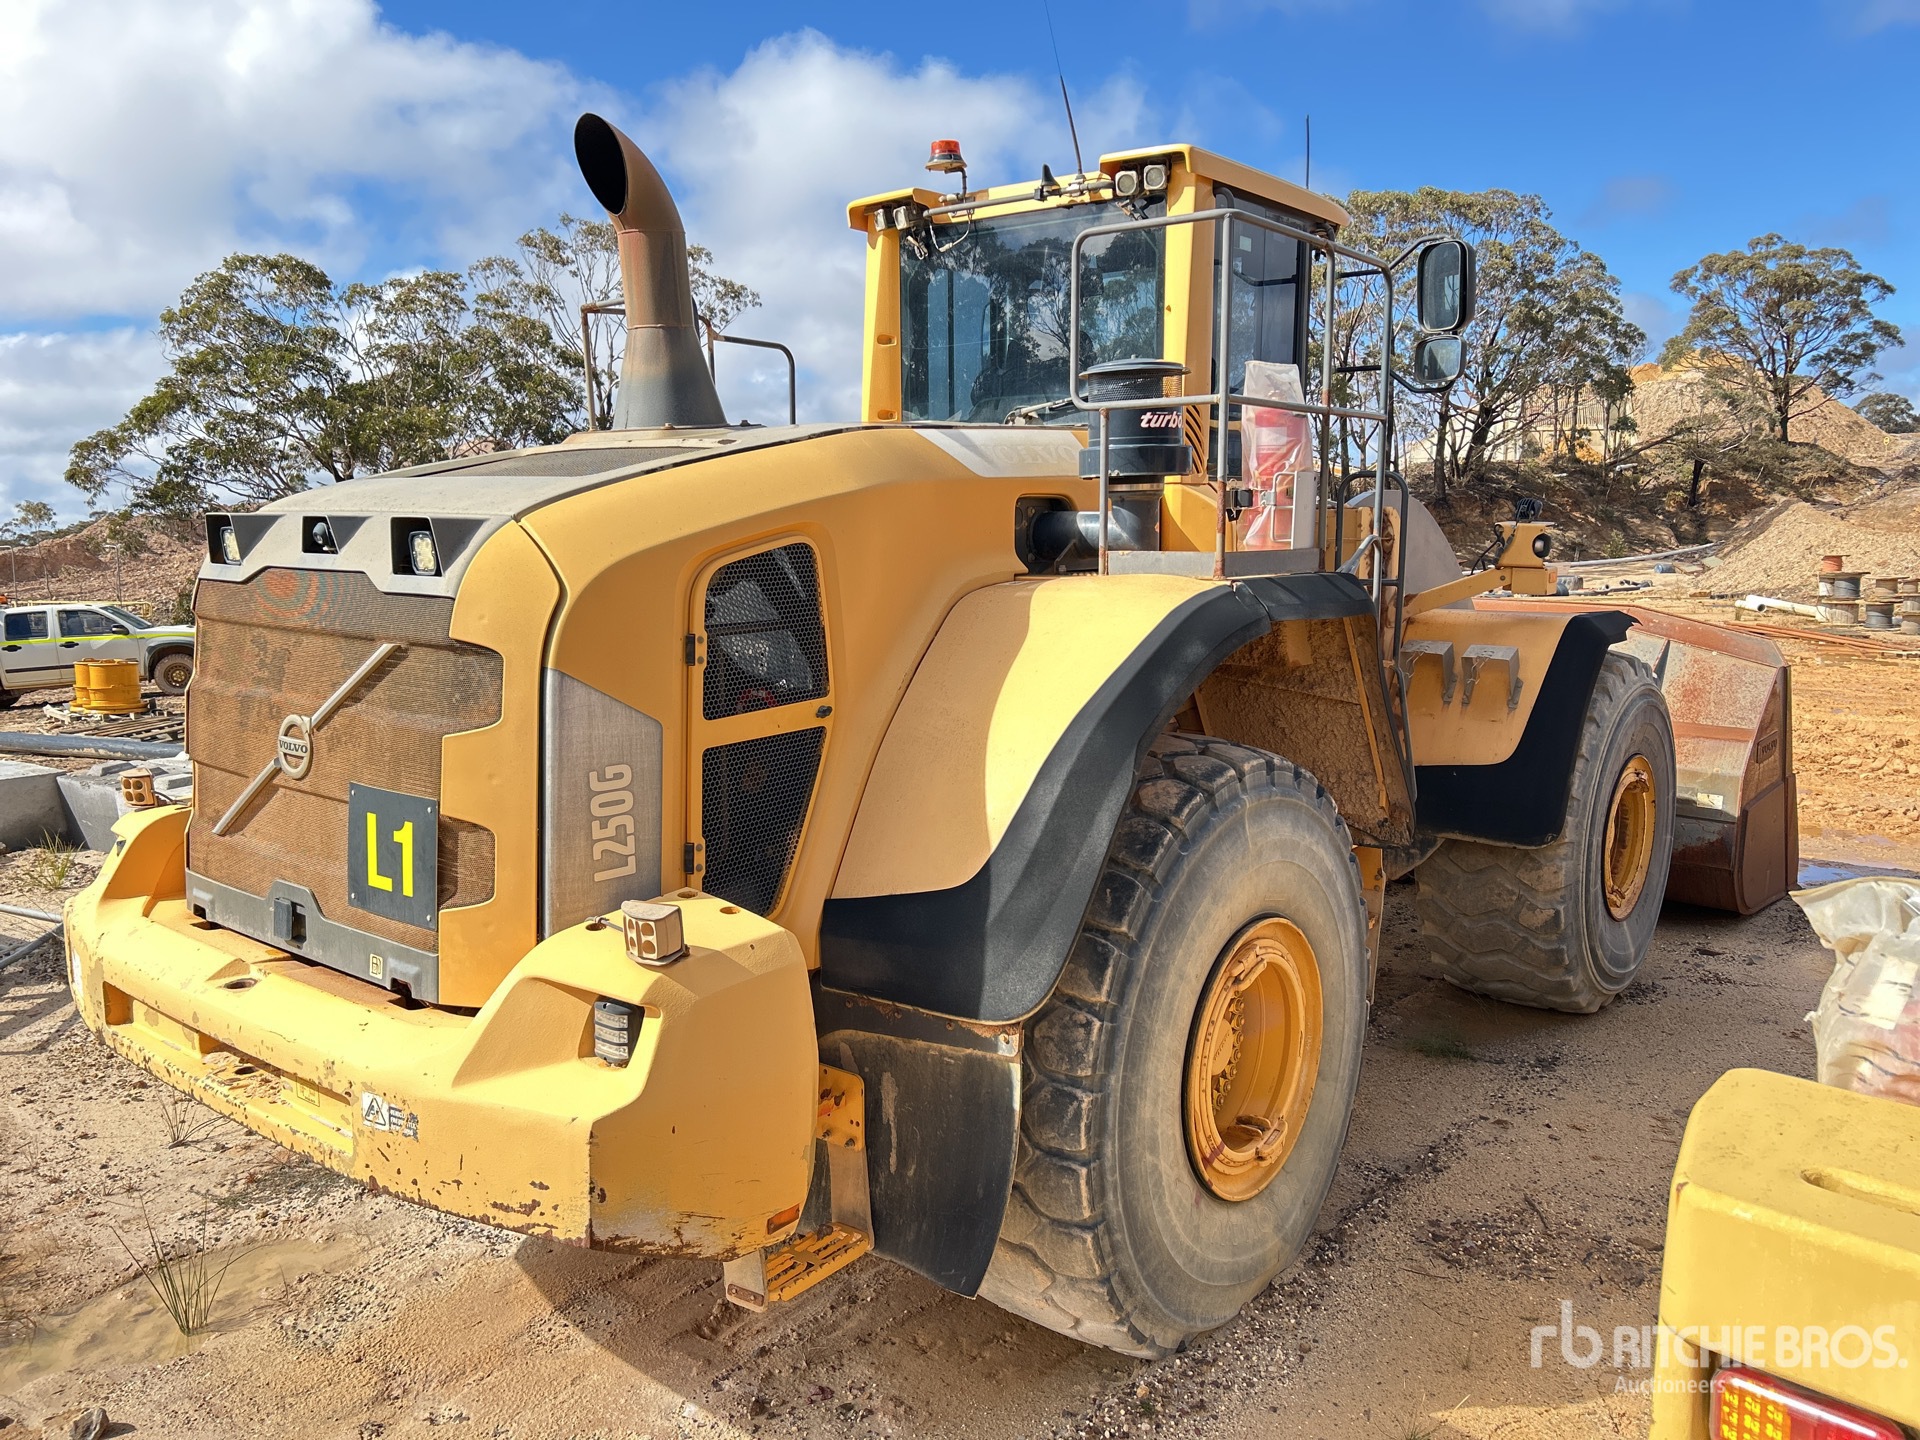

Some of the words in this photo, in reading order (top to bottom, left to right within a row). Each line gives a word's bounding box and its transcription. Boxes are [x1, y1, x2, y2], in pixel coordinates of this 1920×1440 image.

[279, 739, 309, 754] VOLVO
[366, 812, 414, 898] L1
[589, 764, 636, 882] L250G
